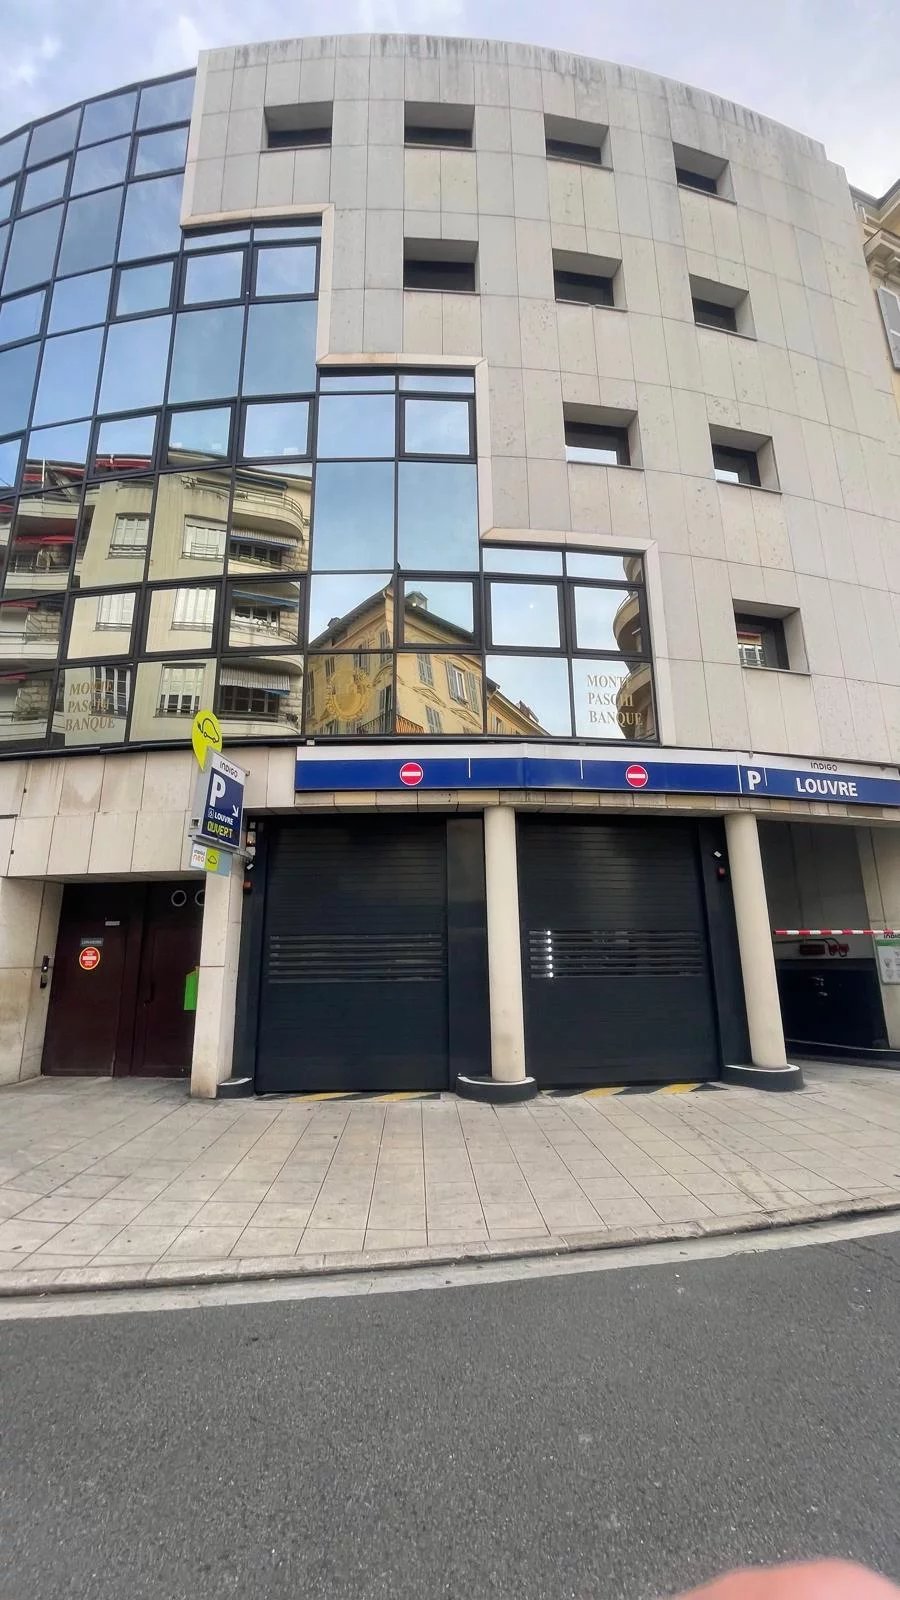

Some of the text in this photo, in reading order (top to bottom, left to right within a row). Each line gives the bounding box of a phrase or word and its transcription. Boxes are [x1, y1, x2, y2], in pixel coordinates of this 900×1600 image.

[65, 716, 115, 732] BANQUE
[589, 710, 643, 727] BANQUE
[209, 773, 226, 807] P
[747, 770, 858, 797] P LOUVRE
[214, 811, 234, 826] LOUVRE
[207, 820, 233, 838] OUVERT
